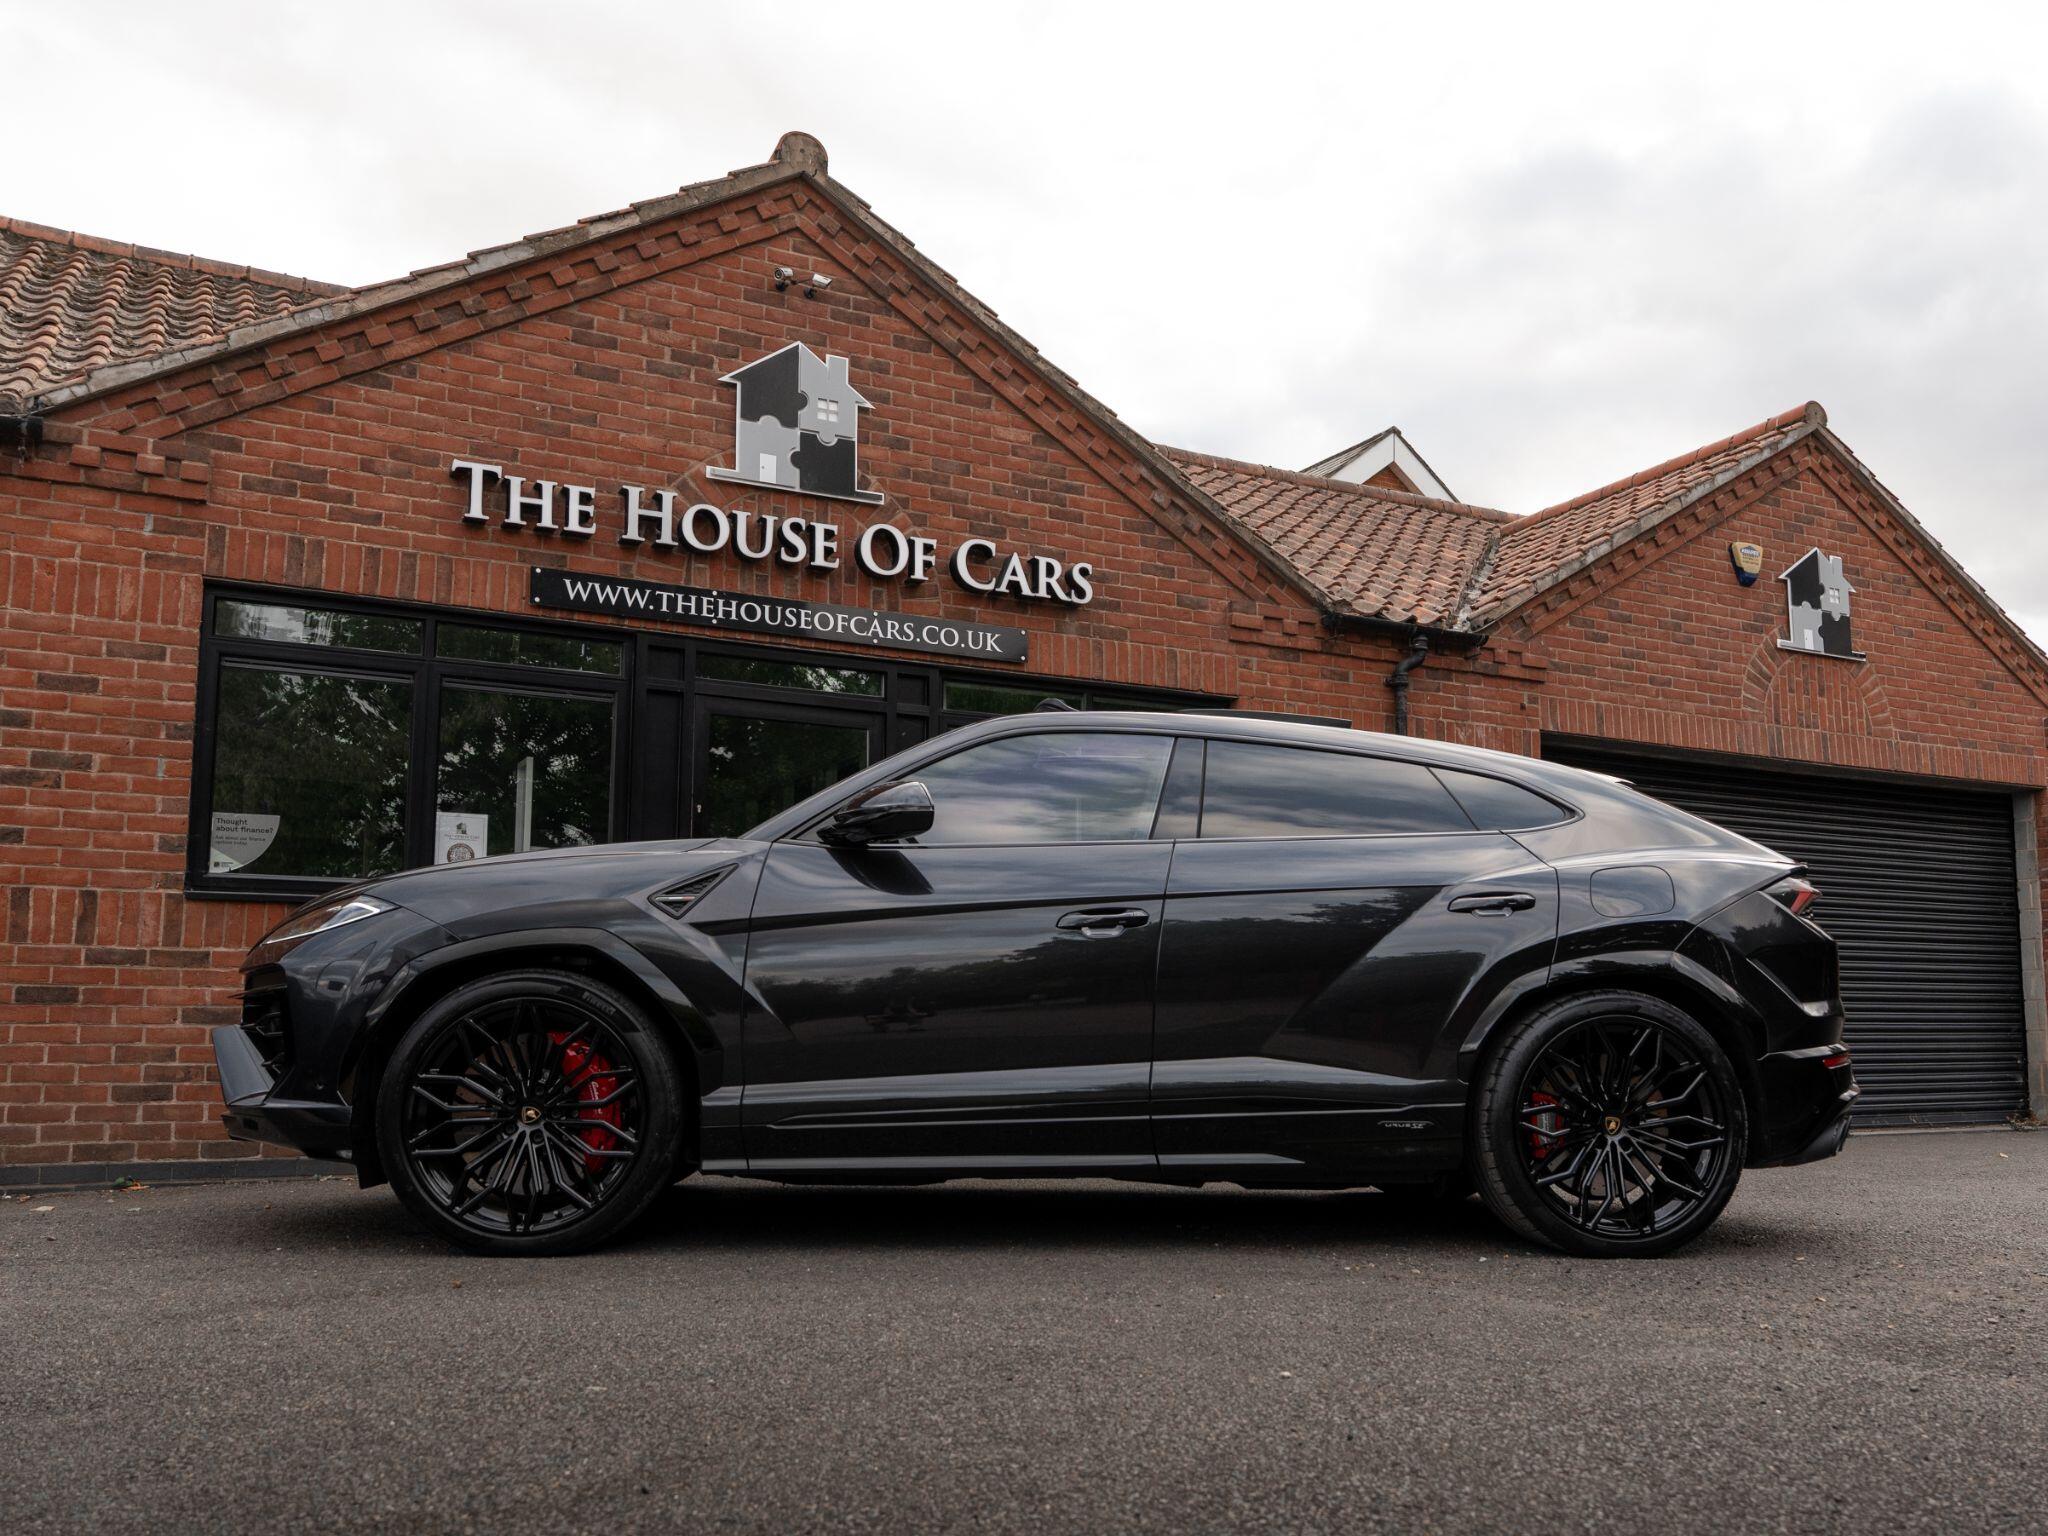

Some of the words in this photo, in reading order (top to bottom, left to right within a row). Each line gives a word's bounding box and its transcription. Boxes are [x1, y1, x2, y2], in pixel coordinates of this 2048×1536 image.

[450, 458, 597, 535] THE
[620, 485, 840, 569] HOUSE
[857, 523, 938, 581] OF
[953, 538, 1094, 605] CARS
[562, 578, 1004, 654] WWW.THEHOUSEOFCARS.CO.UK
[215, 817, 249, 827] Thought
[215, 825, 239, 833] about
[241, 826, 274, 835] finance?
